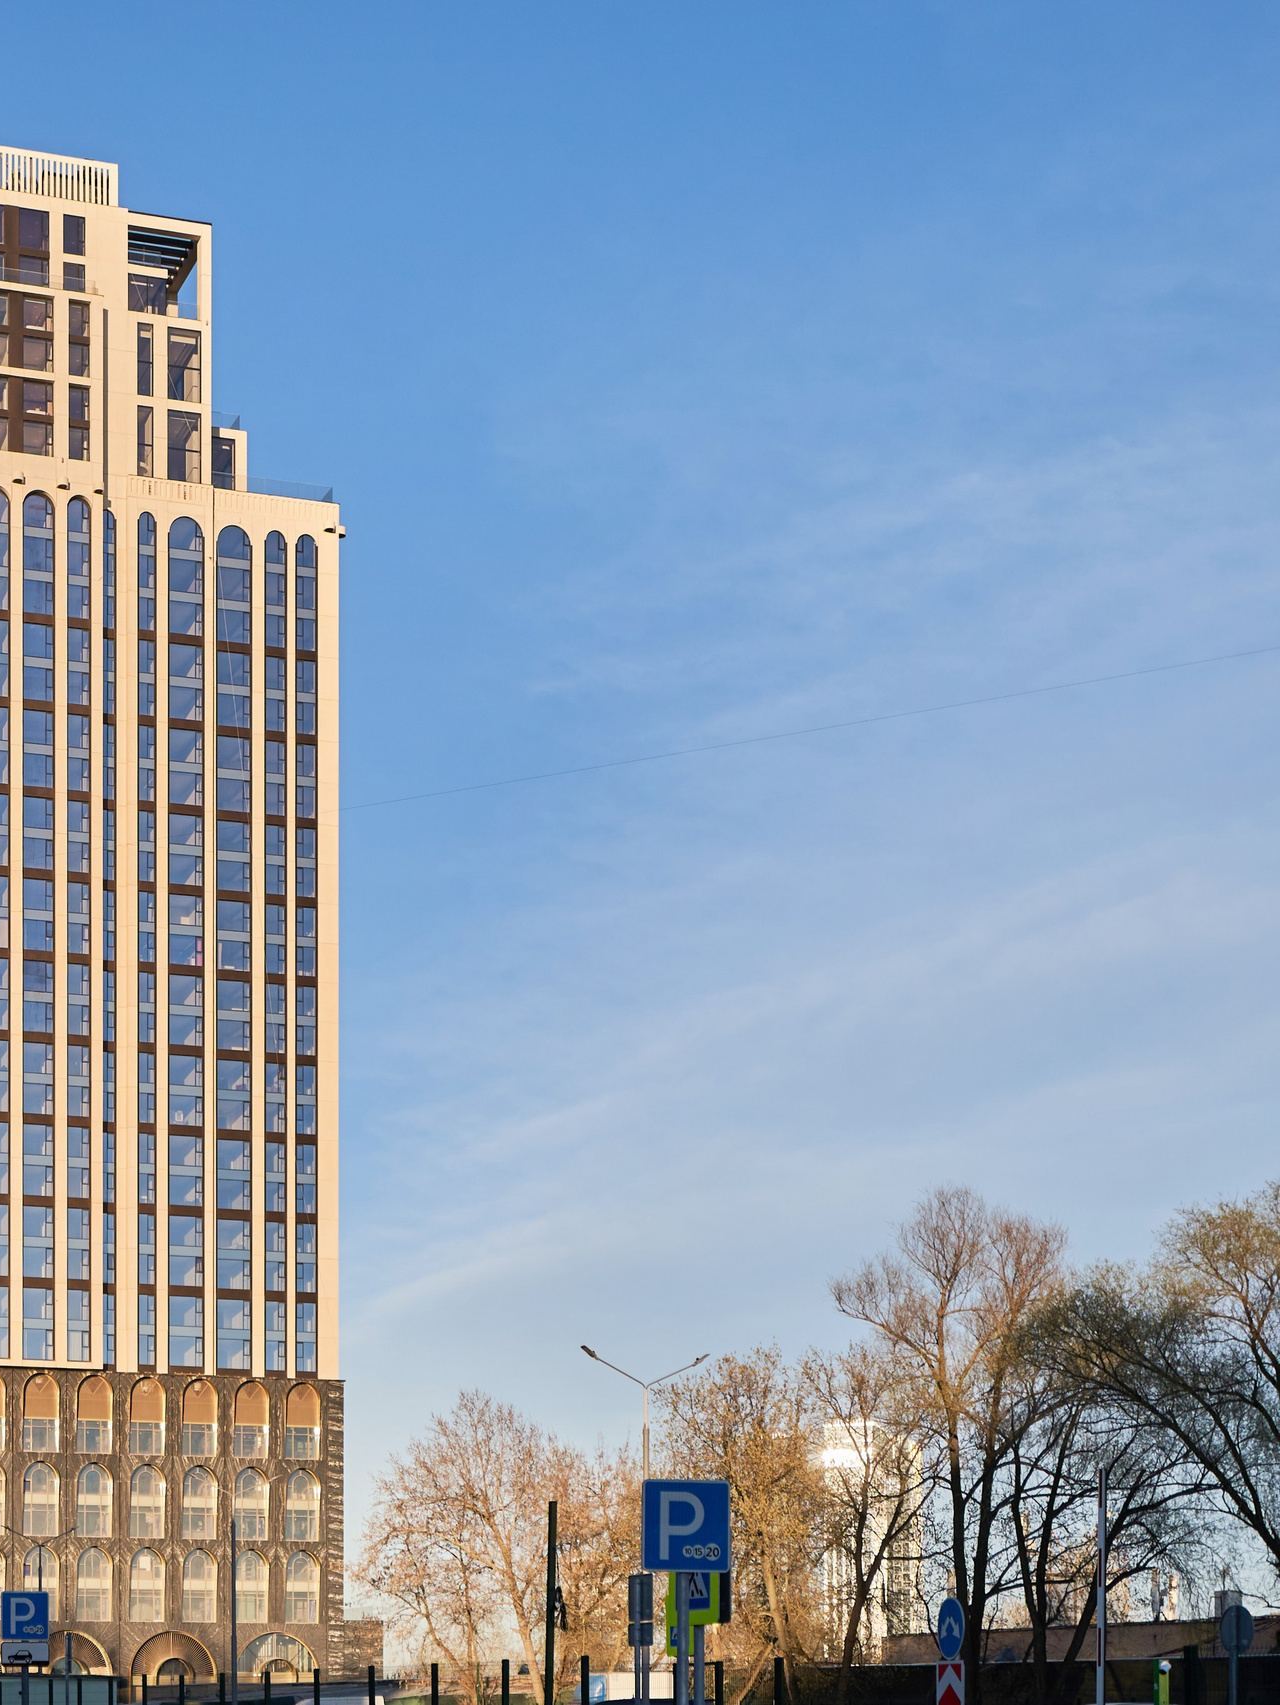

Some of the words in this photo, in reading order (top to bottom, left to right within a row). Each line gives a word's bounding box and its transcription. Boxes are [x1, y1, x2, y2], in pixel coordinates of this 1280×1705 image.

[660, 1491, 705, 1560] P
[685, 1547, 692, 1555] 10
[695, 1547, 703, 1556] 15
[706, 1547, 720, 1558] 20
[10, 1597, 35, 1635] P
